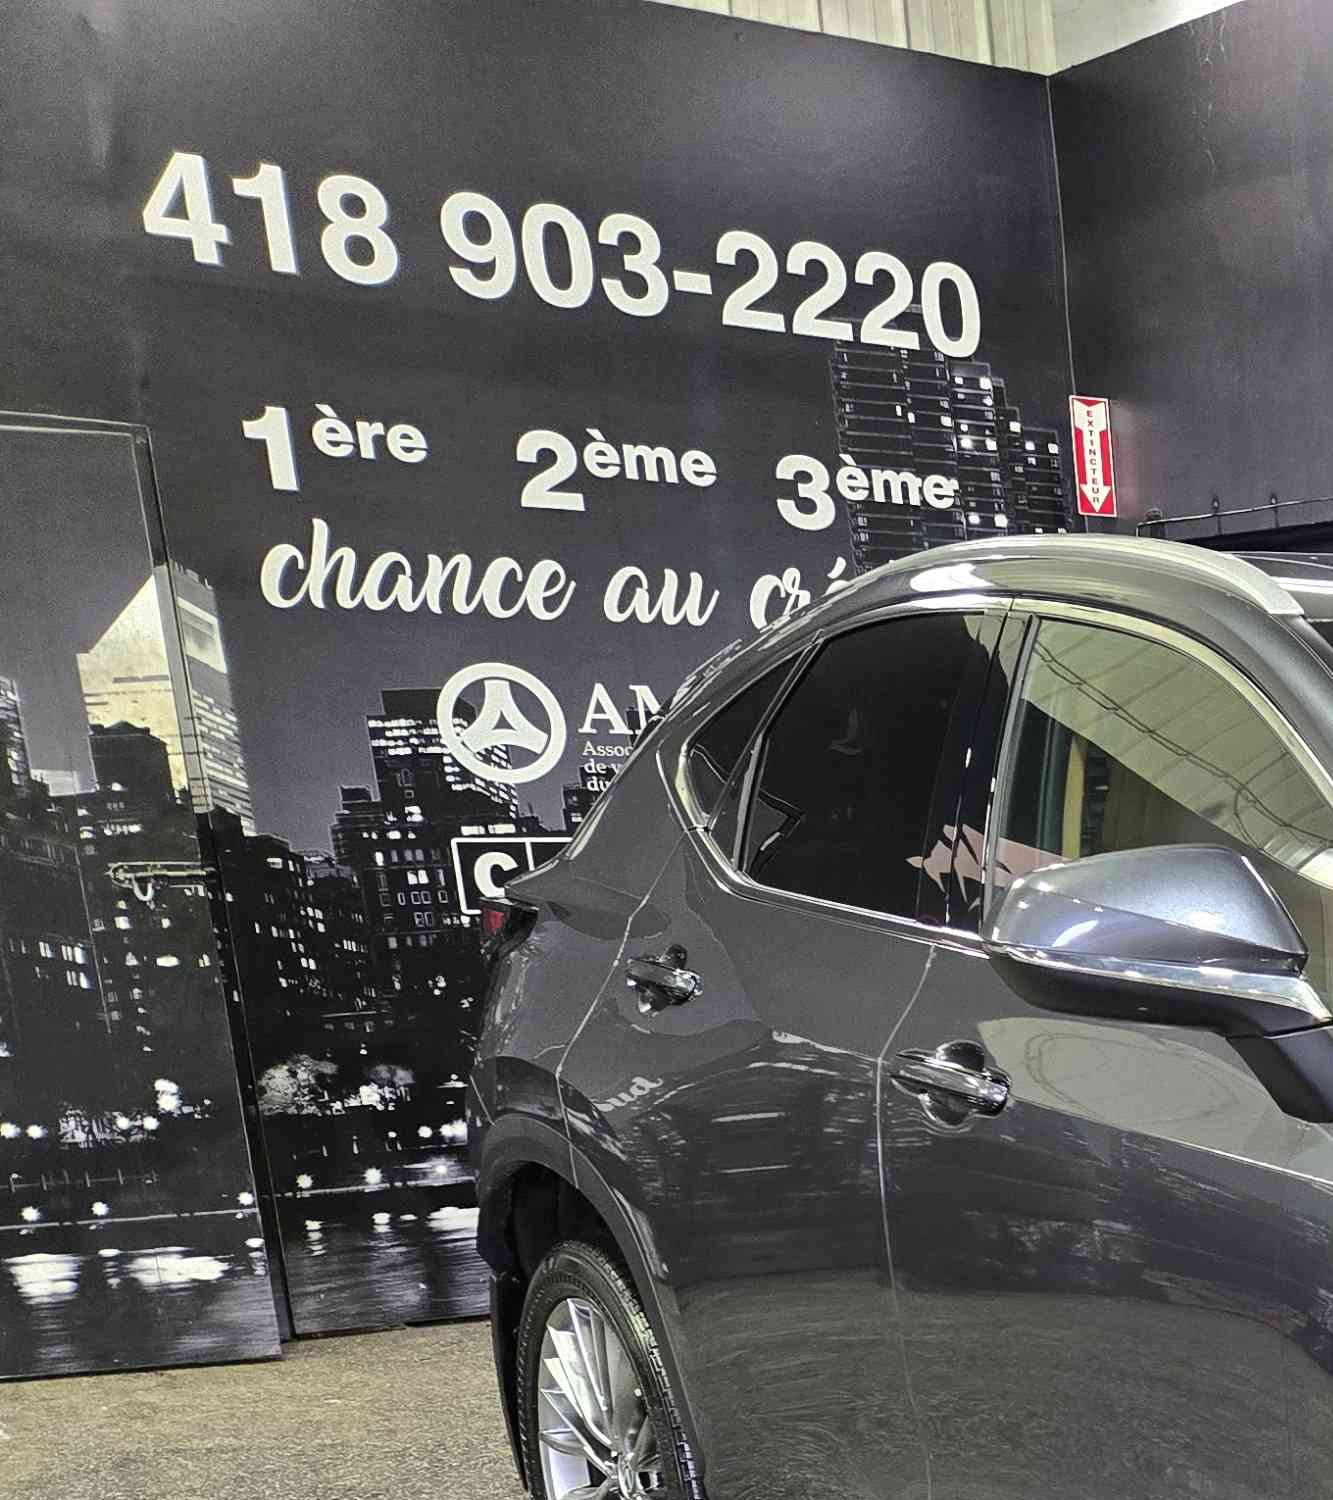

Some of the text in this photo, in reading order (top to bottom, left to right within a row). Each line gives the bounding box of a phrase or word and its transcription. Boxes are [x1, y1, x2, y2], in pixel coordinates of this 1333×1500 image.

[142, 152, 981, 358] 418 903-2220
[242, 403, 956, 531] 1ère 2ème 3ème
[1086, 410, 1100, 503] EXTINCTEUR
[260, 518, 576, 621] chance
[603, 566, 720, 627] au
[584, 758, 607, 774] de
